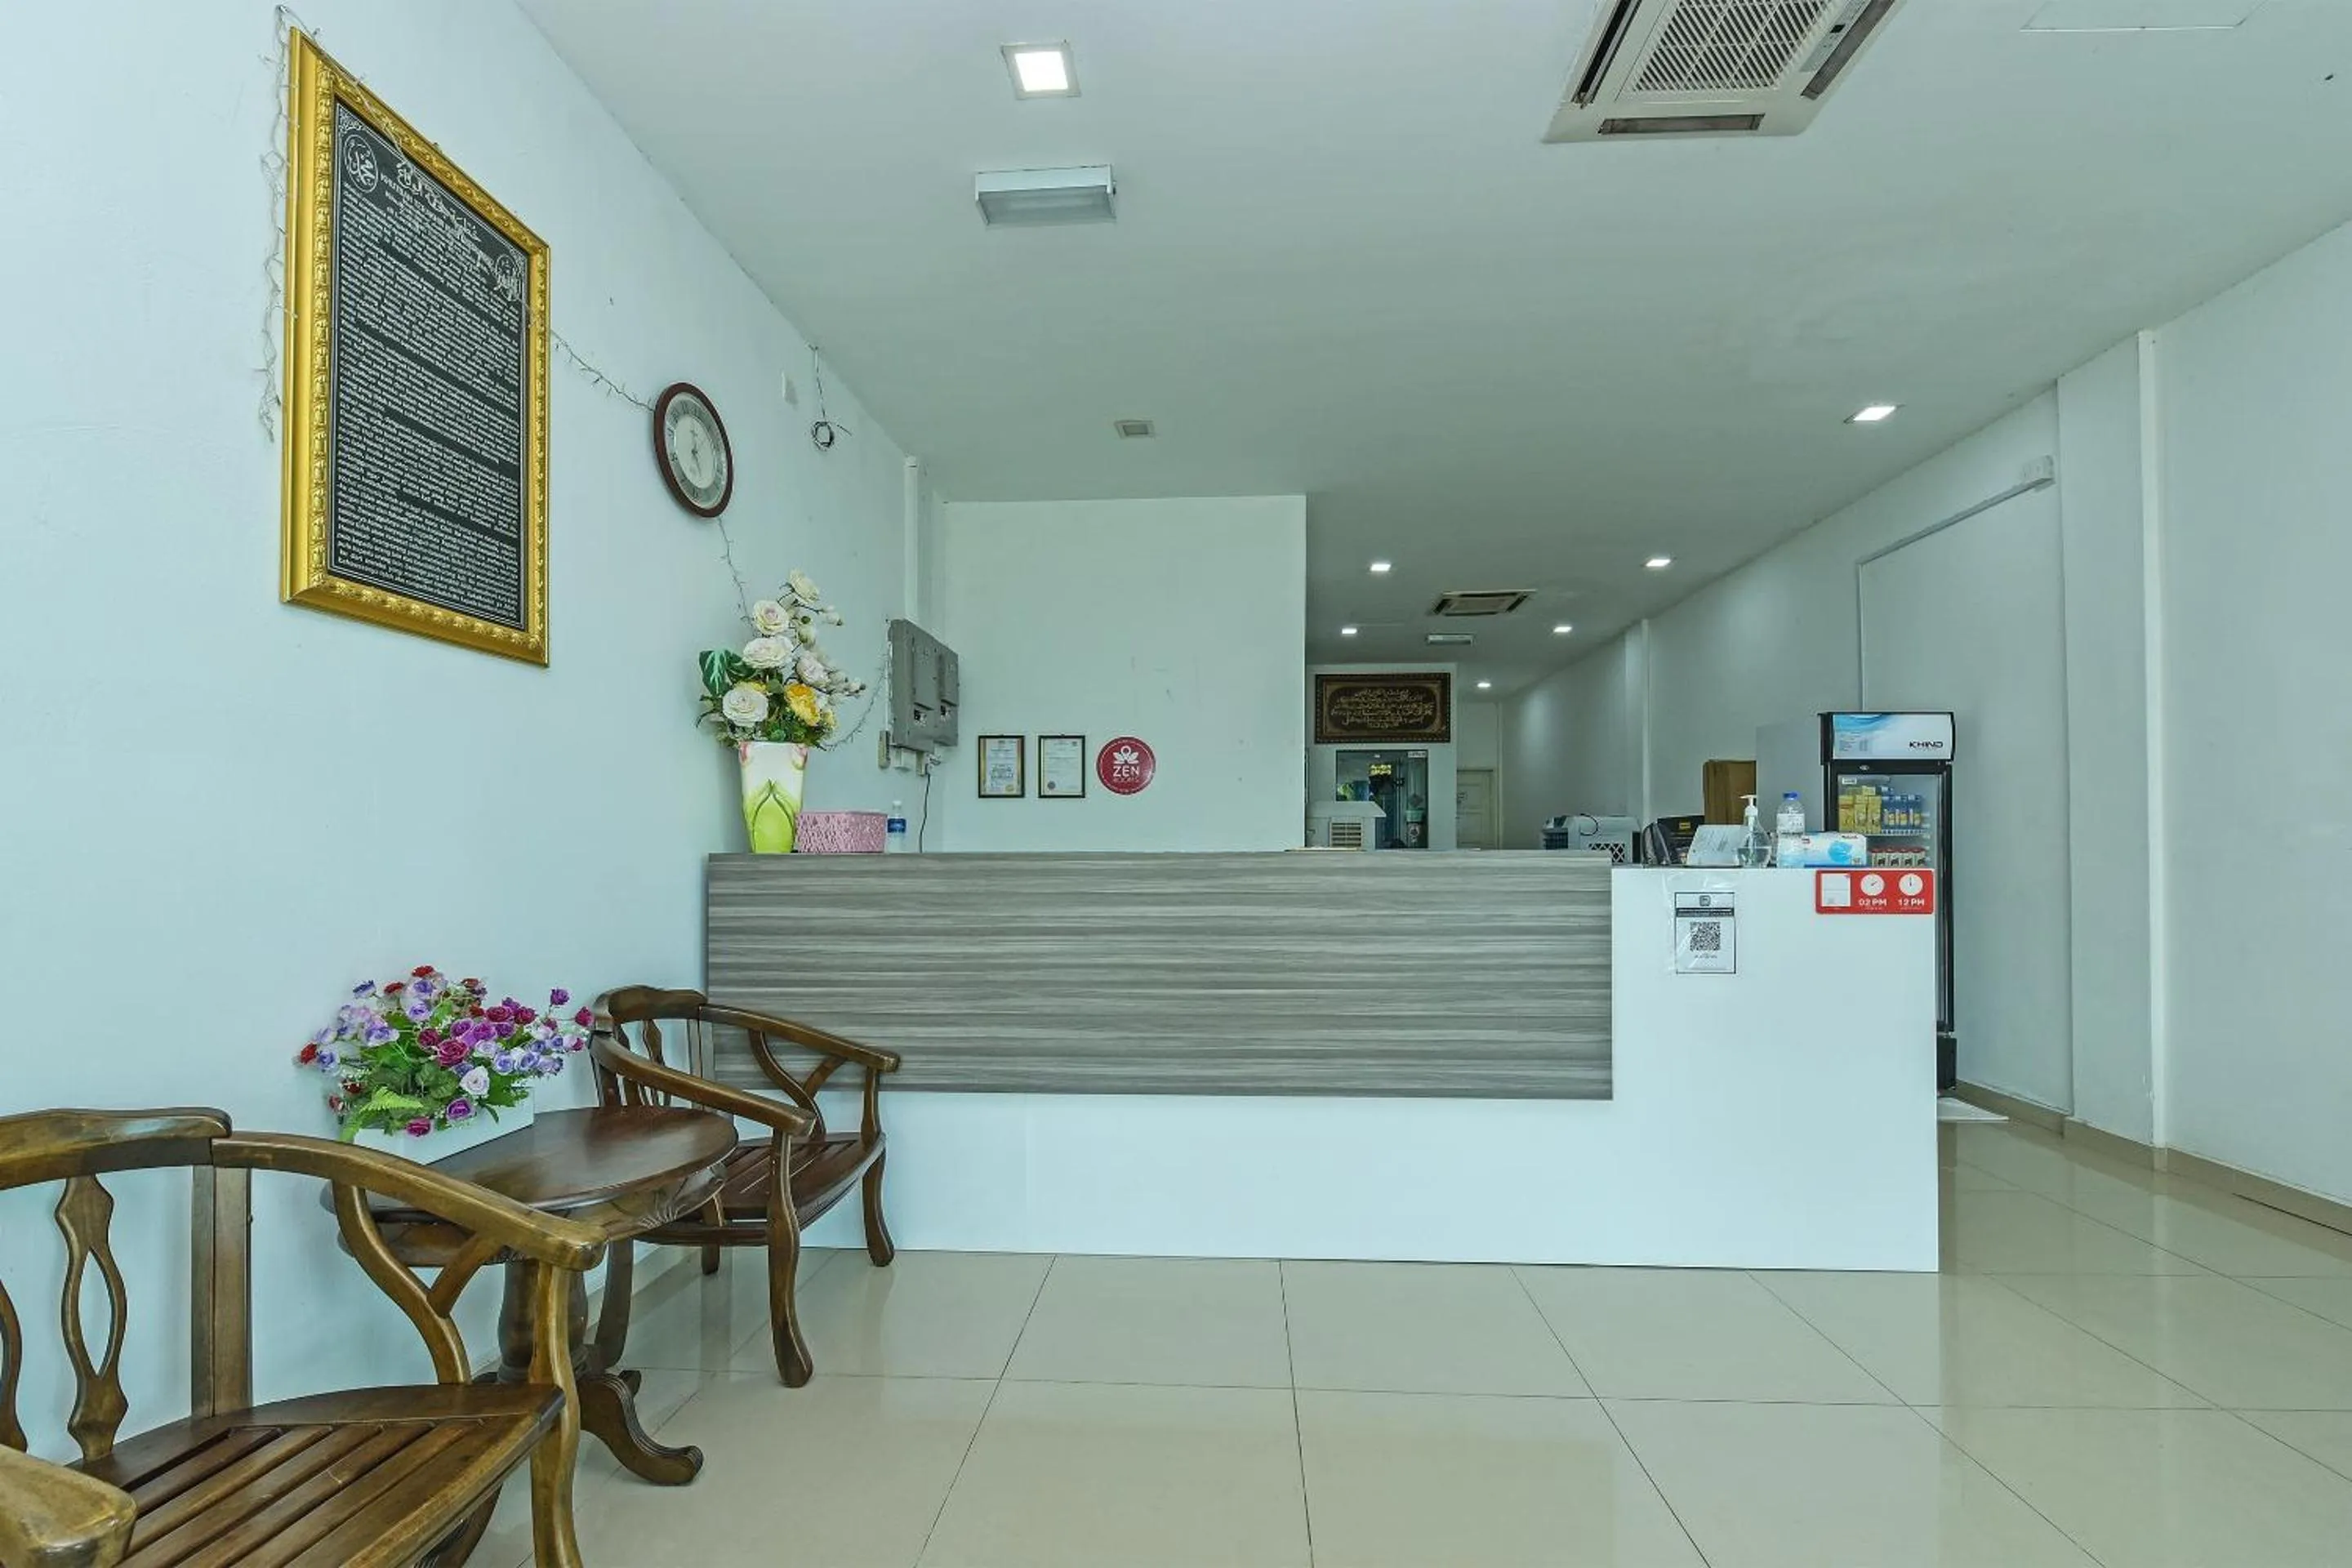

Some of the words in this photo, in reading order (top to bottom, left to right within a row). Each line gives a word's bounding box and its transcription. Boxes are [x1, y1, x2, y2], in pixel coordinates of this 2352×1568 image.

[1112, 765, 1140, 777] ZEN
[1858, 898, 1871, 906] 02
[1872, 898, 1887, 906] PM
[1898, 898, 1909, 906] 12
